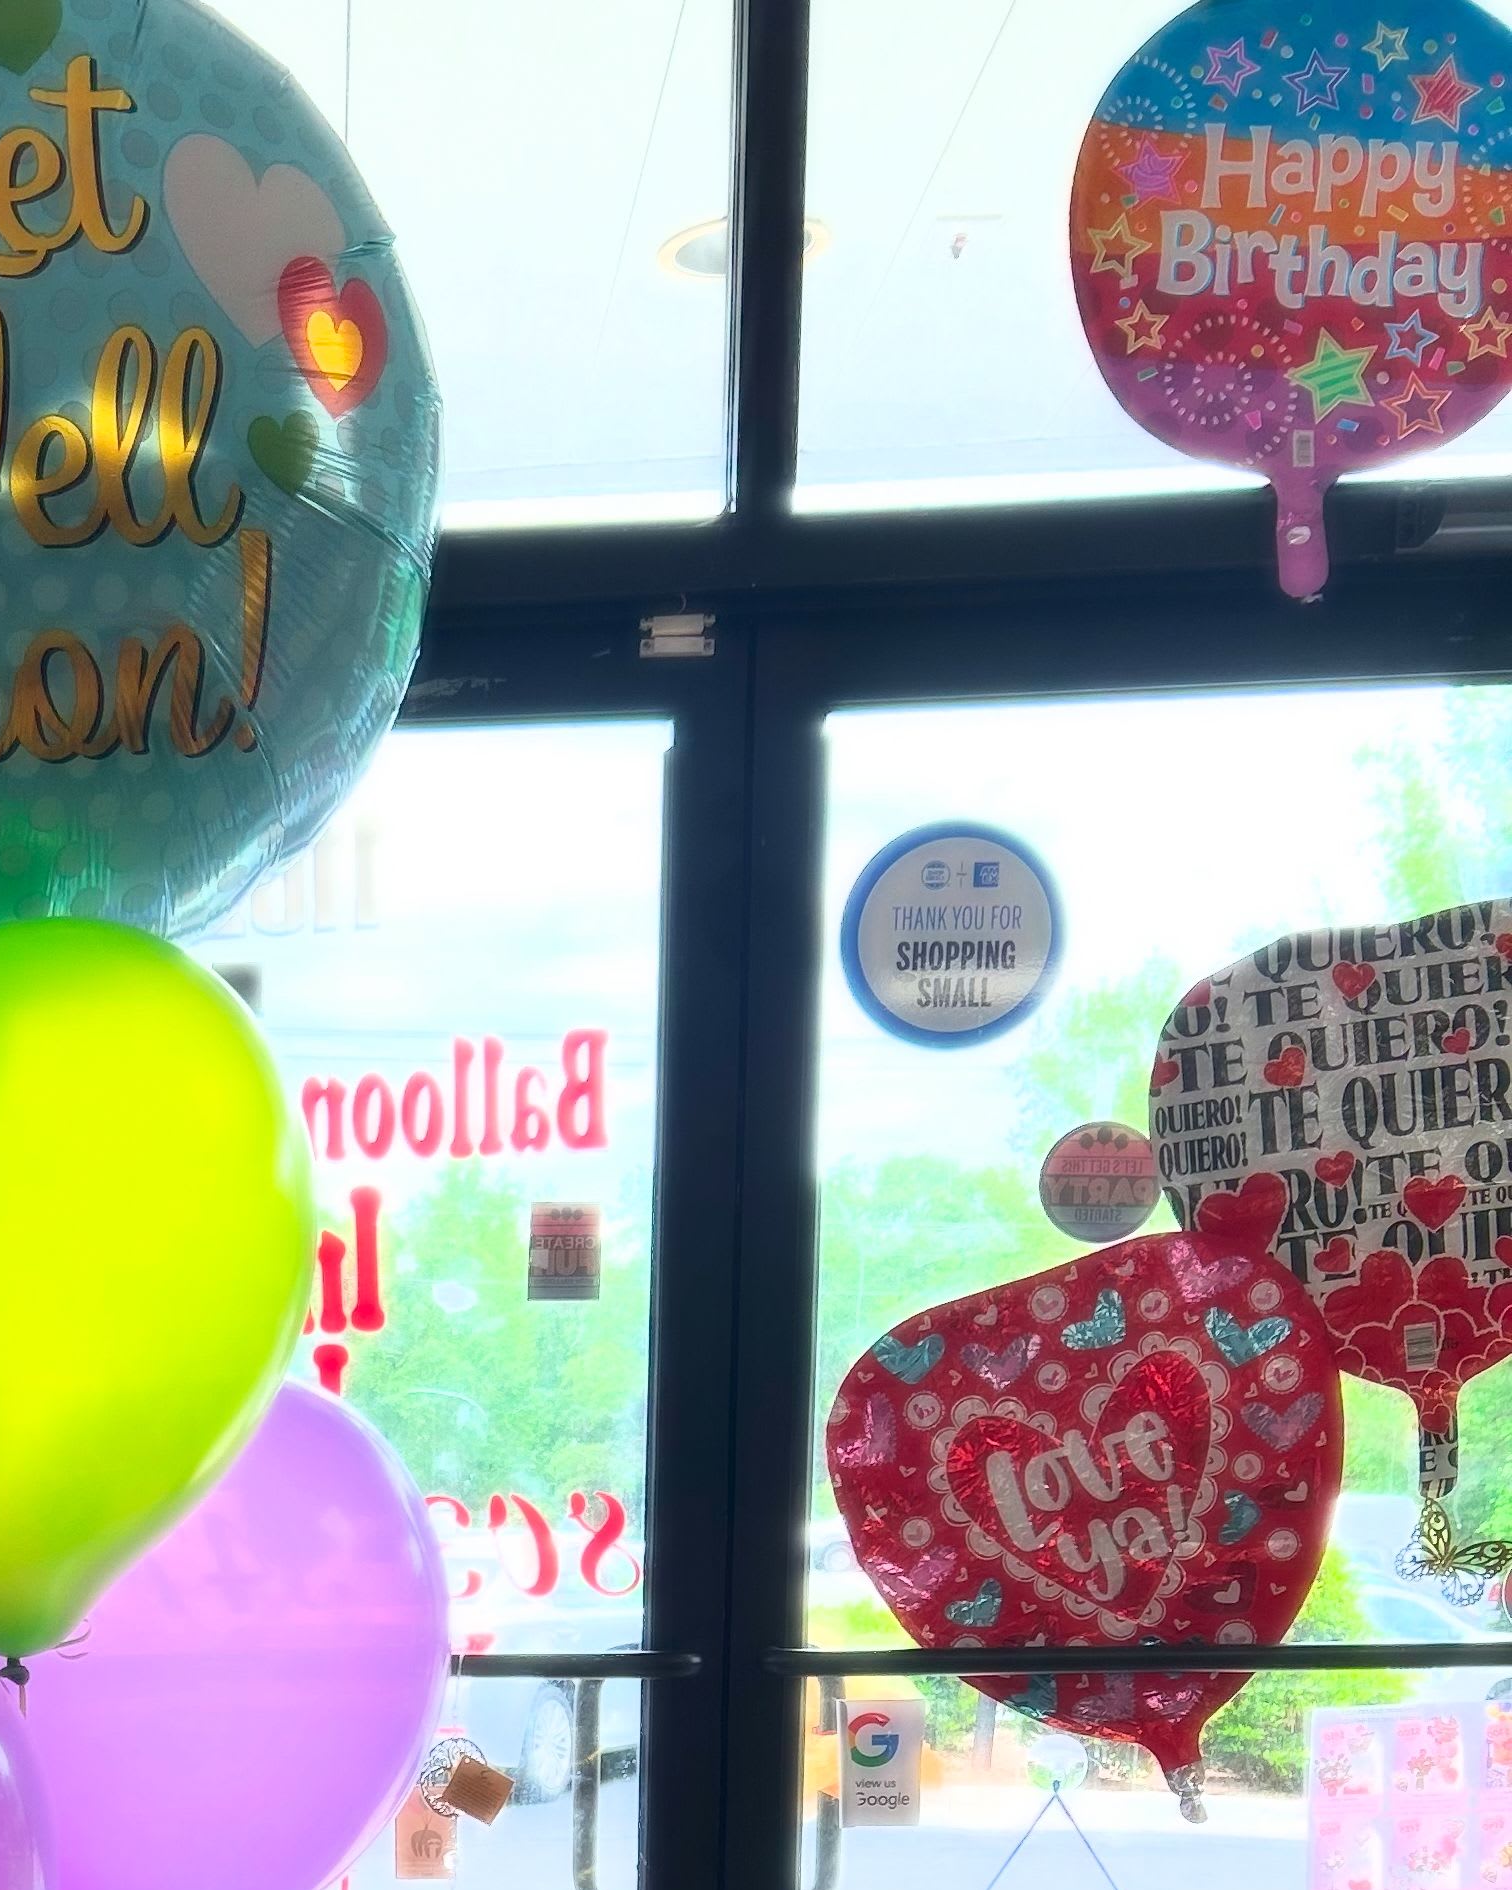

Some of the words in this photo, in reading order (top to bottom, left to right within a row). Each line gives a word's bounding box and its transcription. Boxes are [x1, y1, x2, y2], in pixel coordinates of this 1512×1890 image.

[1200, 122, 1459, 217] Happy
[1156, 209, 1485, 318] Birthday
[892, 906, 947, 931] THANK
[953, 906, 985, 930] YOU
[991, 905, 1022, 930] FOR
[896, 940, 1016, 971] SHOPPING
[917, 977, 991, 1008] SMALL
[1243, 980, 1323, 1028] TE
[1168, 1038, 1248, 1093] TE
[1155, 1095, 1243, 1138] QUIERO!
[1248, 1080, 1324, 1156] TE
[1159, 1132, 1248, 1182] QUIERO!
[987, 1412, 1179, 1552] Love
[1056, 1486, 1190, 1600] ya!
[855, 1778, 881, 1788] view
[884, 1780, 896, 1788] us
